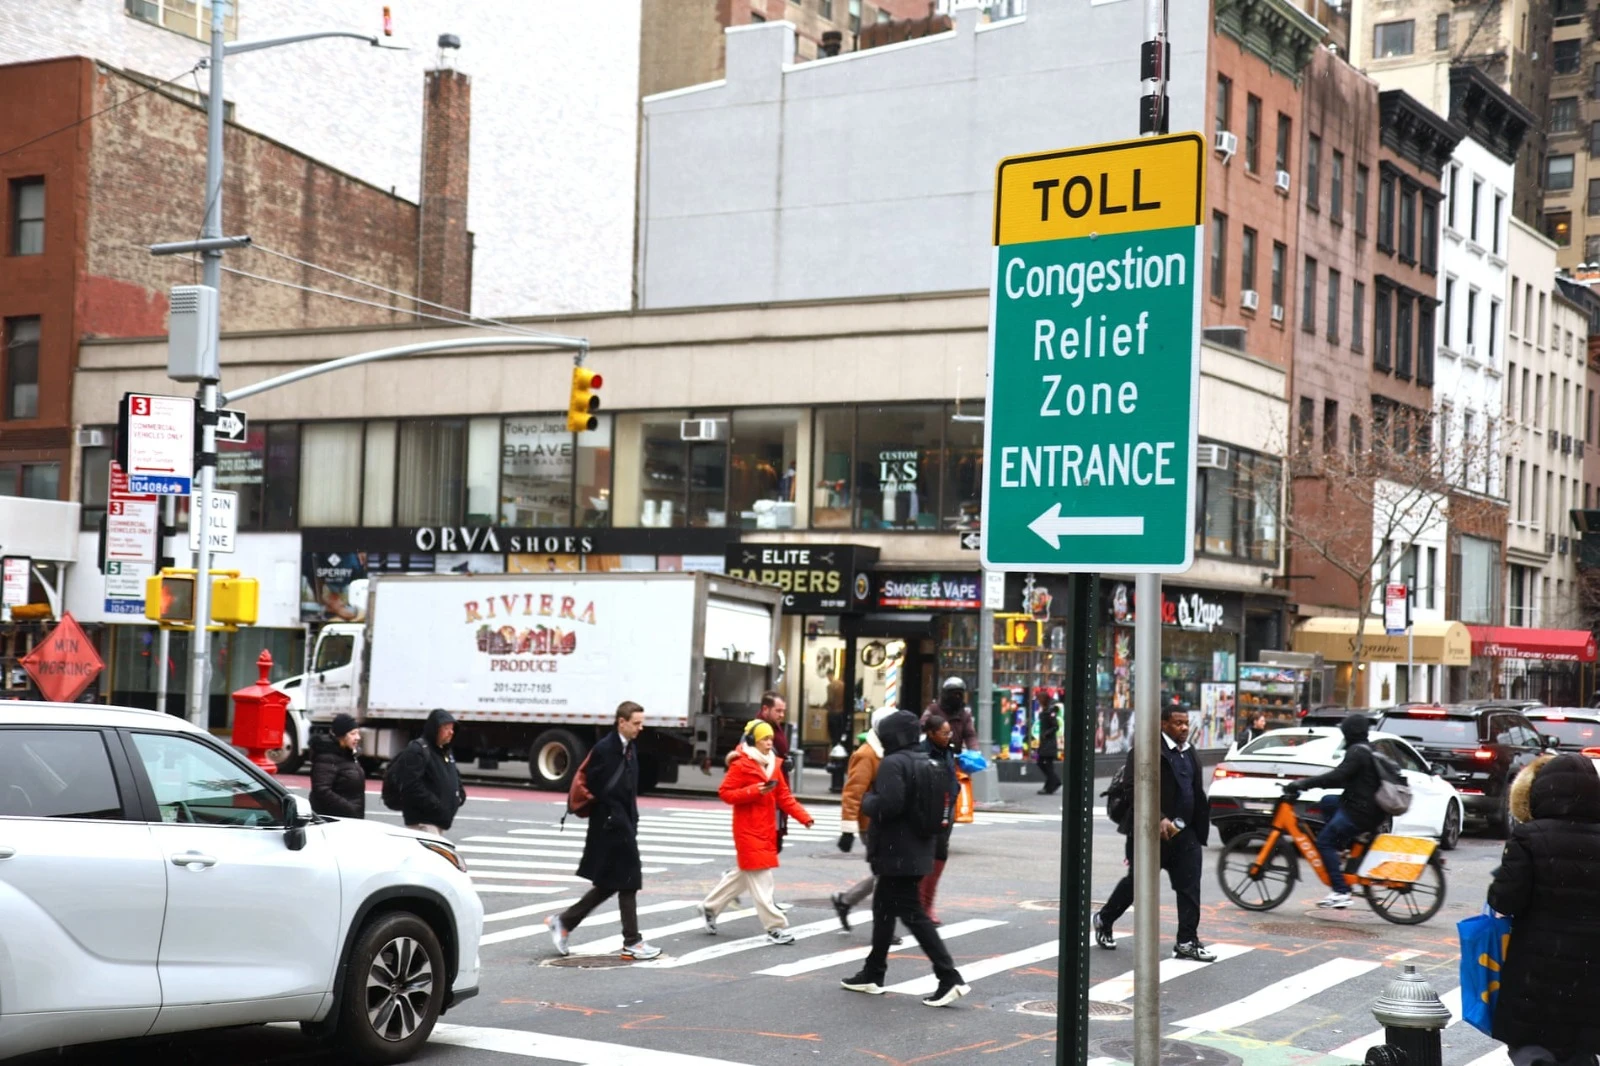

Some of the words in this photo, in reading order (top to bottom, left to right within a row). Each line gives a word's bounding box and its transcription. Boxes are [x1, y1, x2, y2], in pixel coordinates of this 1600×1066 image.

[1032, 168, 1161, 222] TOLL
[1004, 246, 1186, 308] Congestion
[1034, 311, 1149, 361] Relief
[1040, 374, 1138, 417] Zone
[135, 398, 148, 415] 3
[504, 421, 537, 435] Tokyo
[503, 443, 572, 457] BRAVE
[879, 451, 918, 460] CUSTOM
[1000, 441, 1175, 488] ENTRANCE
[131, 481, 169, 493] 104086
[113, 502, 122, 514] 3
[196, 496, 231, 509] BGIN
[415, 526, 501, 551] ORVA
[510, 536, 593, 553] SHOES
[762, 549, 811, 565] ELITE
[109, 563, 119, 575] 5
[316, 567, 352, 578] SPERRY
[885, 581, 928, 598] SMOKE
[930, 580, 941, 598] &
[943, 582, 977, 599] VAPE
[464, 593, 597, 625] RIVIERA
[1191, 593, 1224, 633] Vape
[55, 639, 79, 652] MN
[1347, 638, 1399, 656] Szanne
[490, 659, 558, 672] PRODUCE
